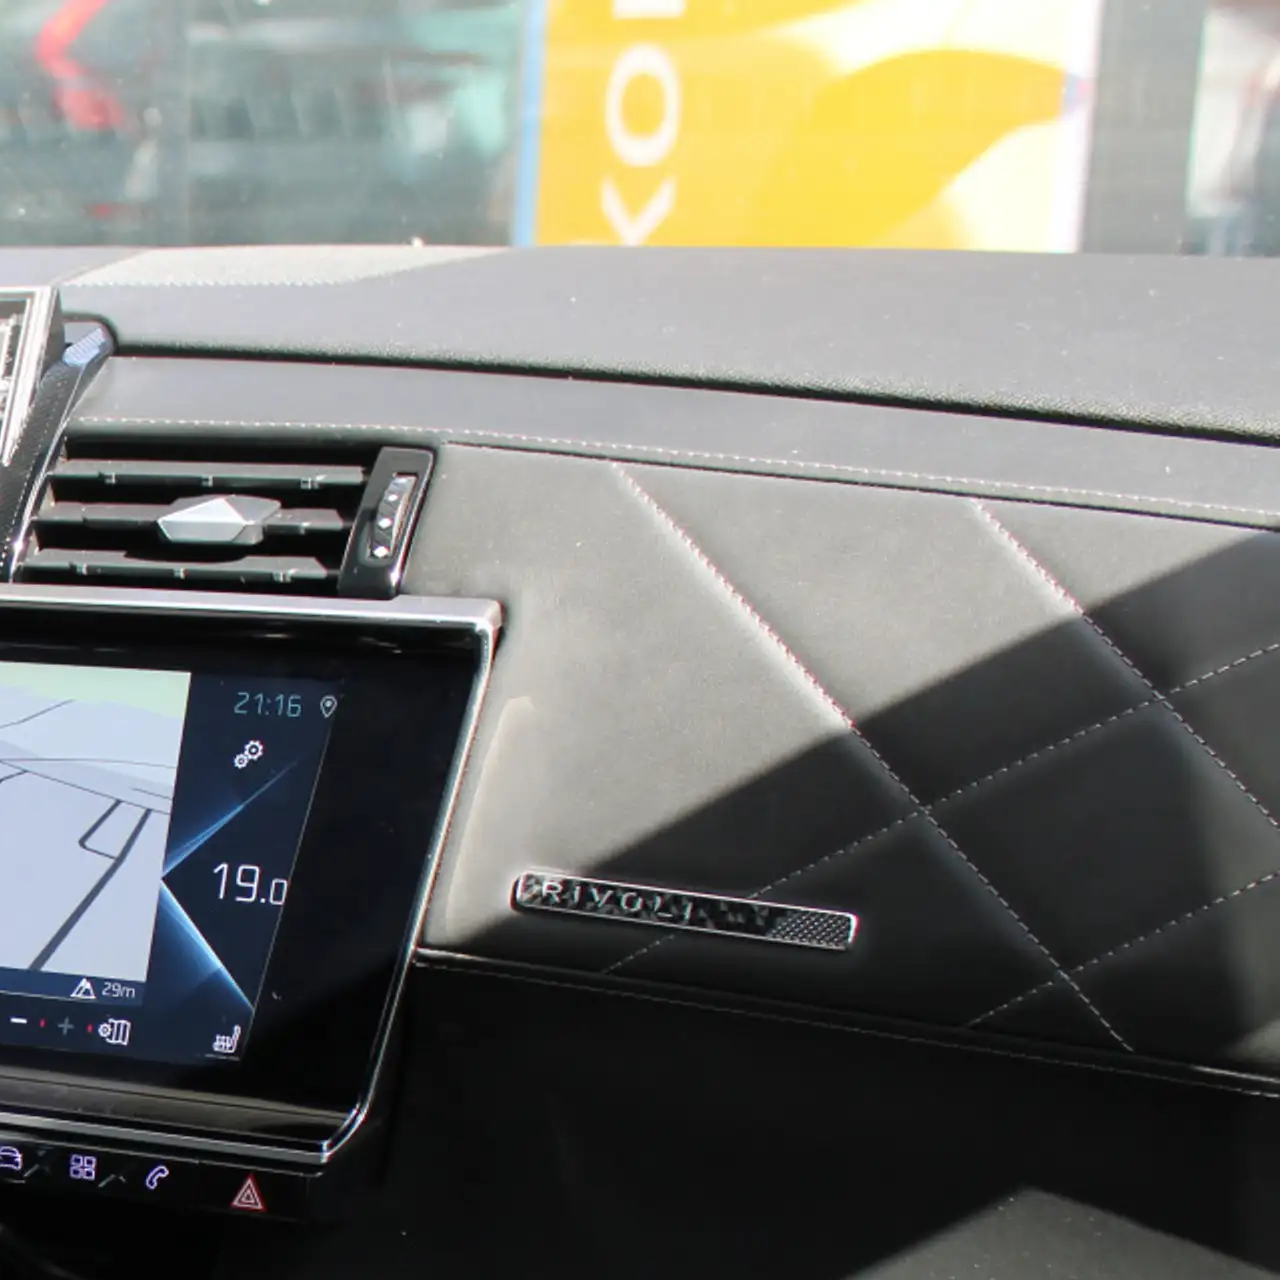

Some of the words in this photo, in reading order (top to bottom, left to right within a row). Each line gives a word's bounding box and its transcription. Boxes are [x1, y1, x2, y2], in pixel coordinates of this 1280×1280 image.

[233, 691, 302, 718] 21:16
[213, 862, 288, 905] 19.0
[541, 880, 694, 924] RIVOLI
[101, 981, 136, 999] 29m
